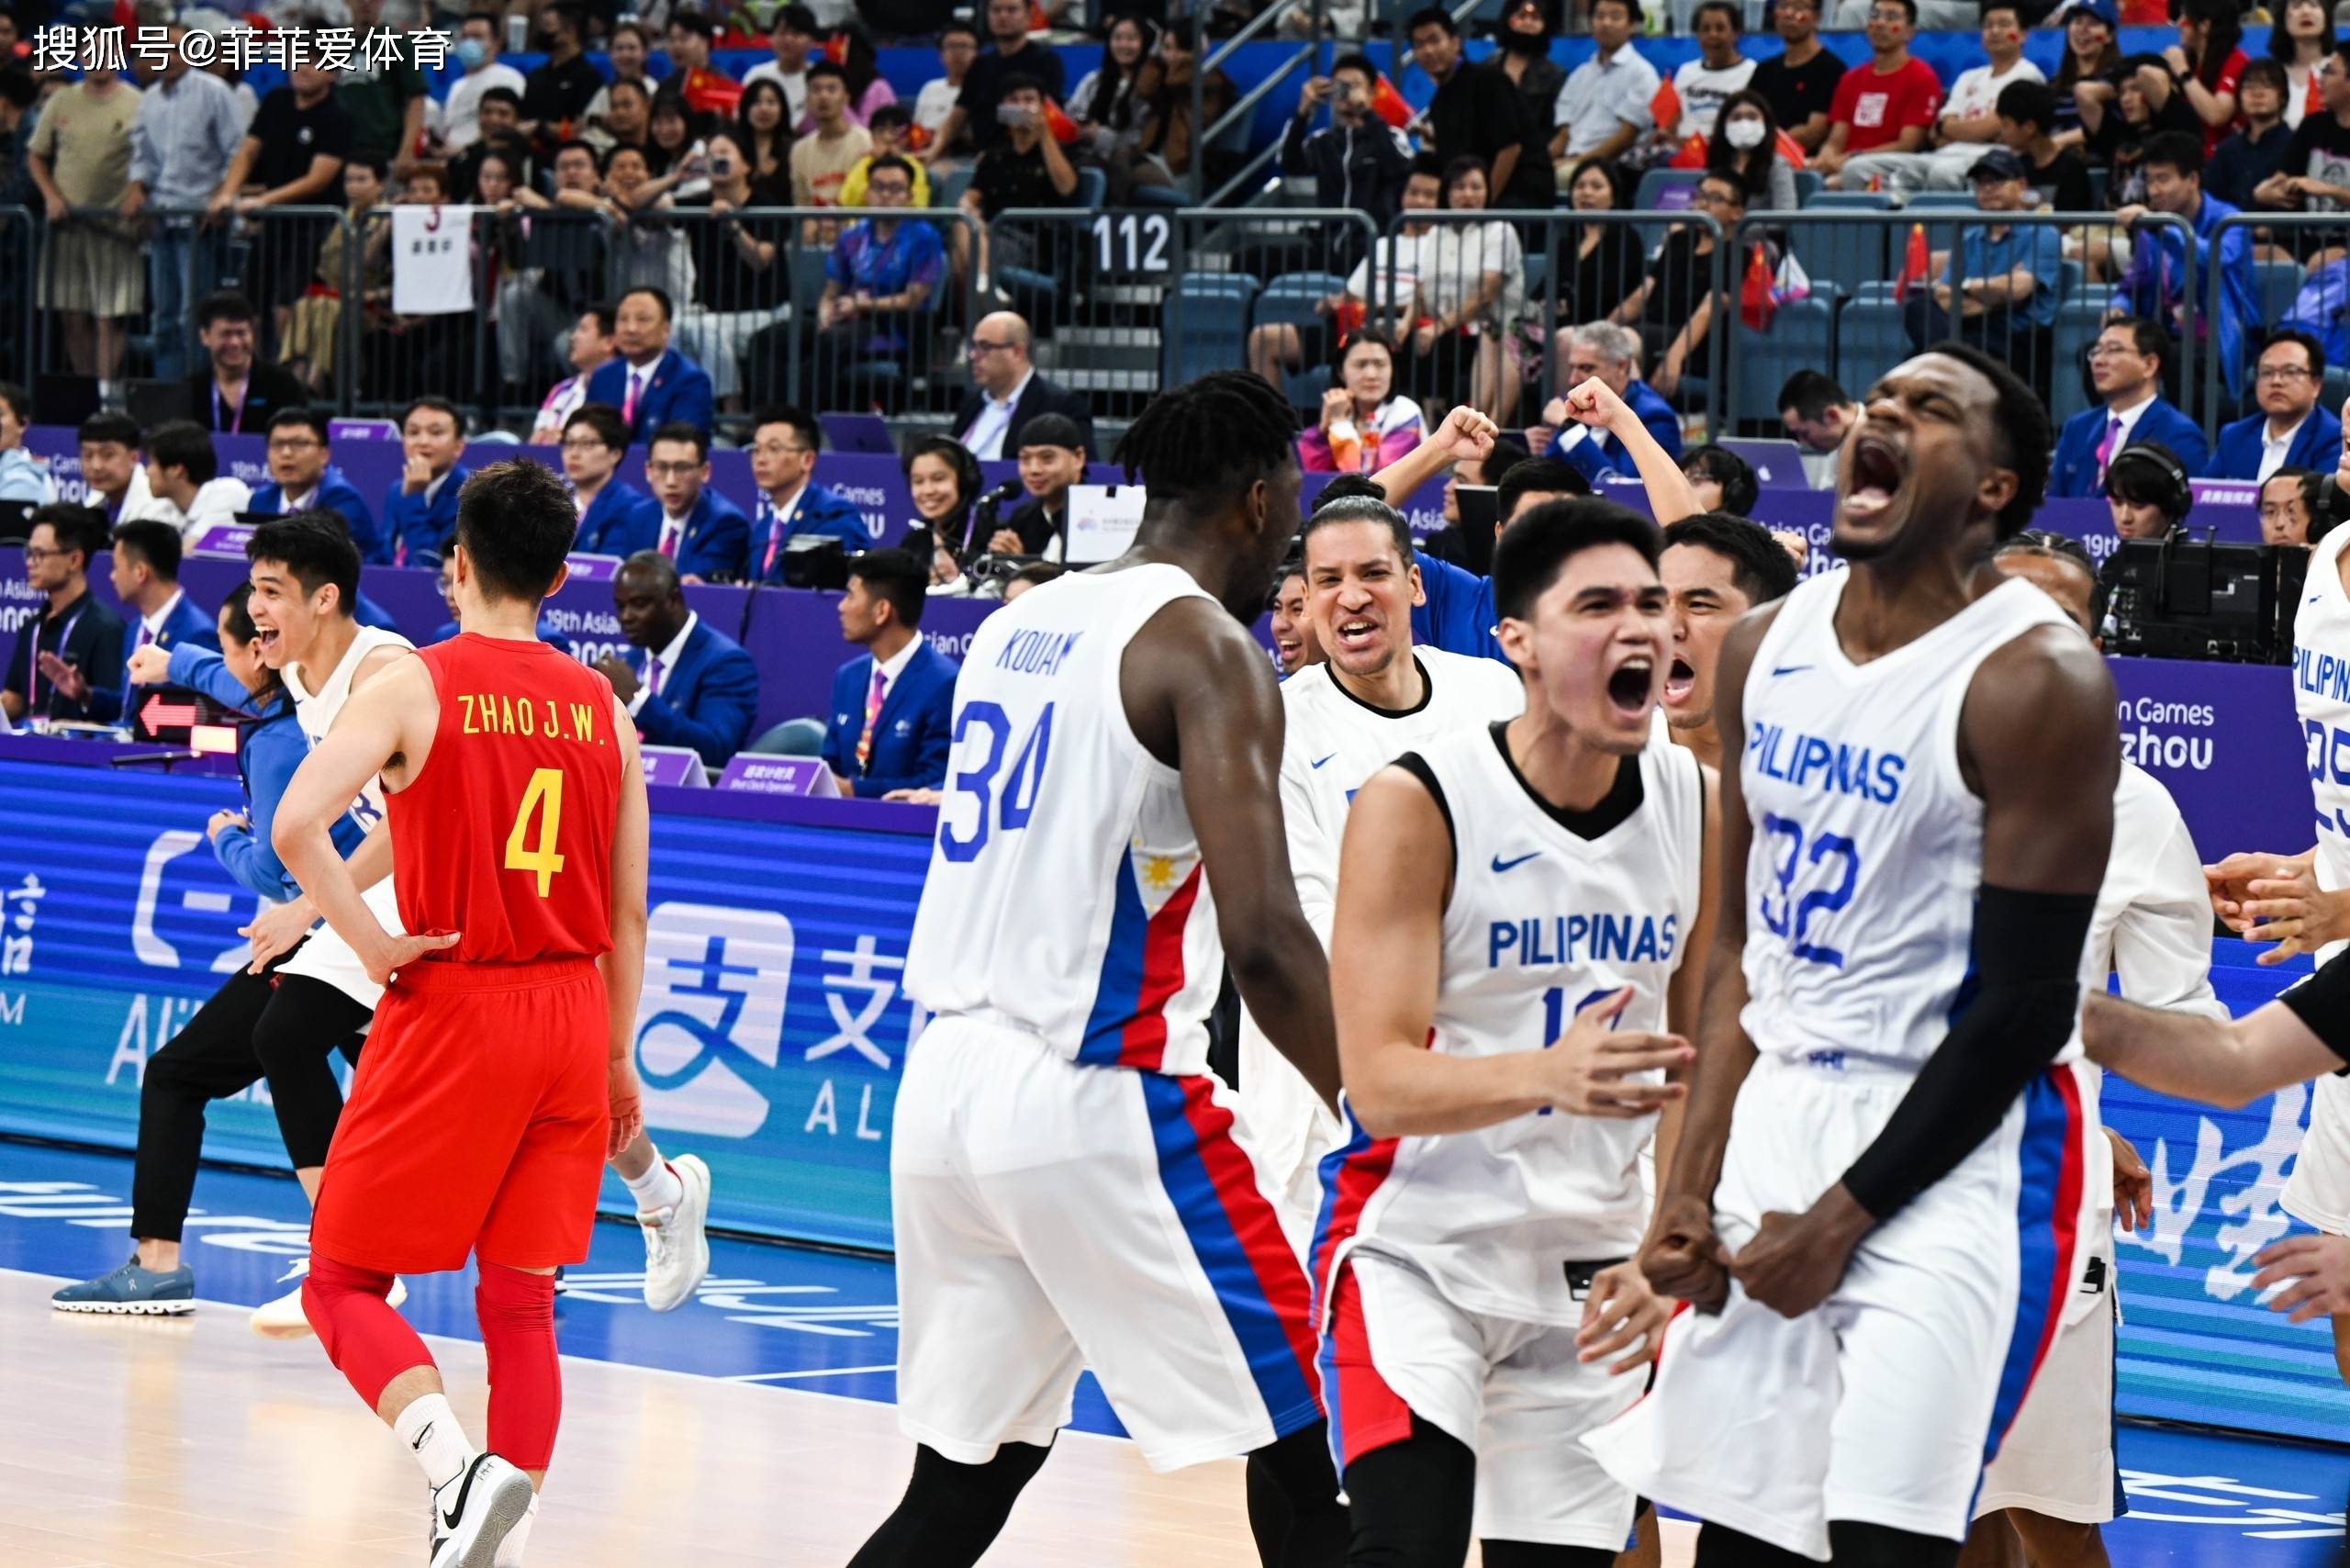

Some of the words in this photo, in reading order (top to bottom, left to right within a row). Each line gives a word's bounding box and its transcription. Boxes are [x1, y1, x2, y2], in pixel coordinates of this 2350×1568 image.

[1092, 214, 1169, 272] 112
[457, 694, 534, 736] ZHAO
[543, 700, 605, 745] J.W.
[2135, 697, 2215, 726] Games
[940, 700, 1055, 863] 34
[504, 767, 565, 898] 4
[1762, 812, 1860, 969] 32
[1488, 913, 1682, 969] PILIPINAS
[804, 935, 905, 1070] 支
